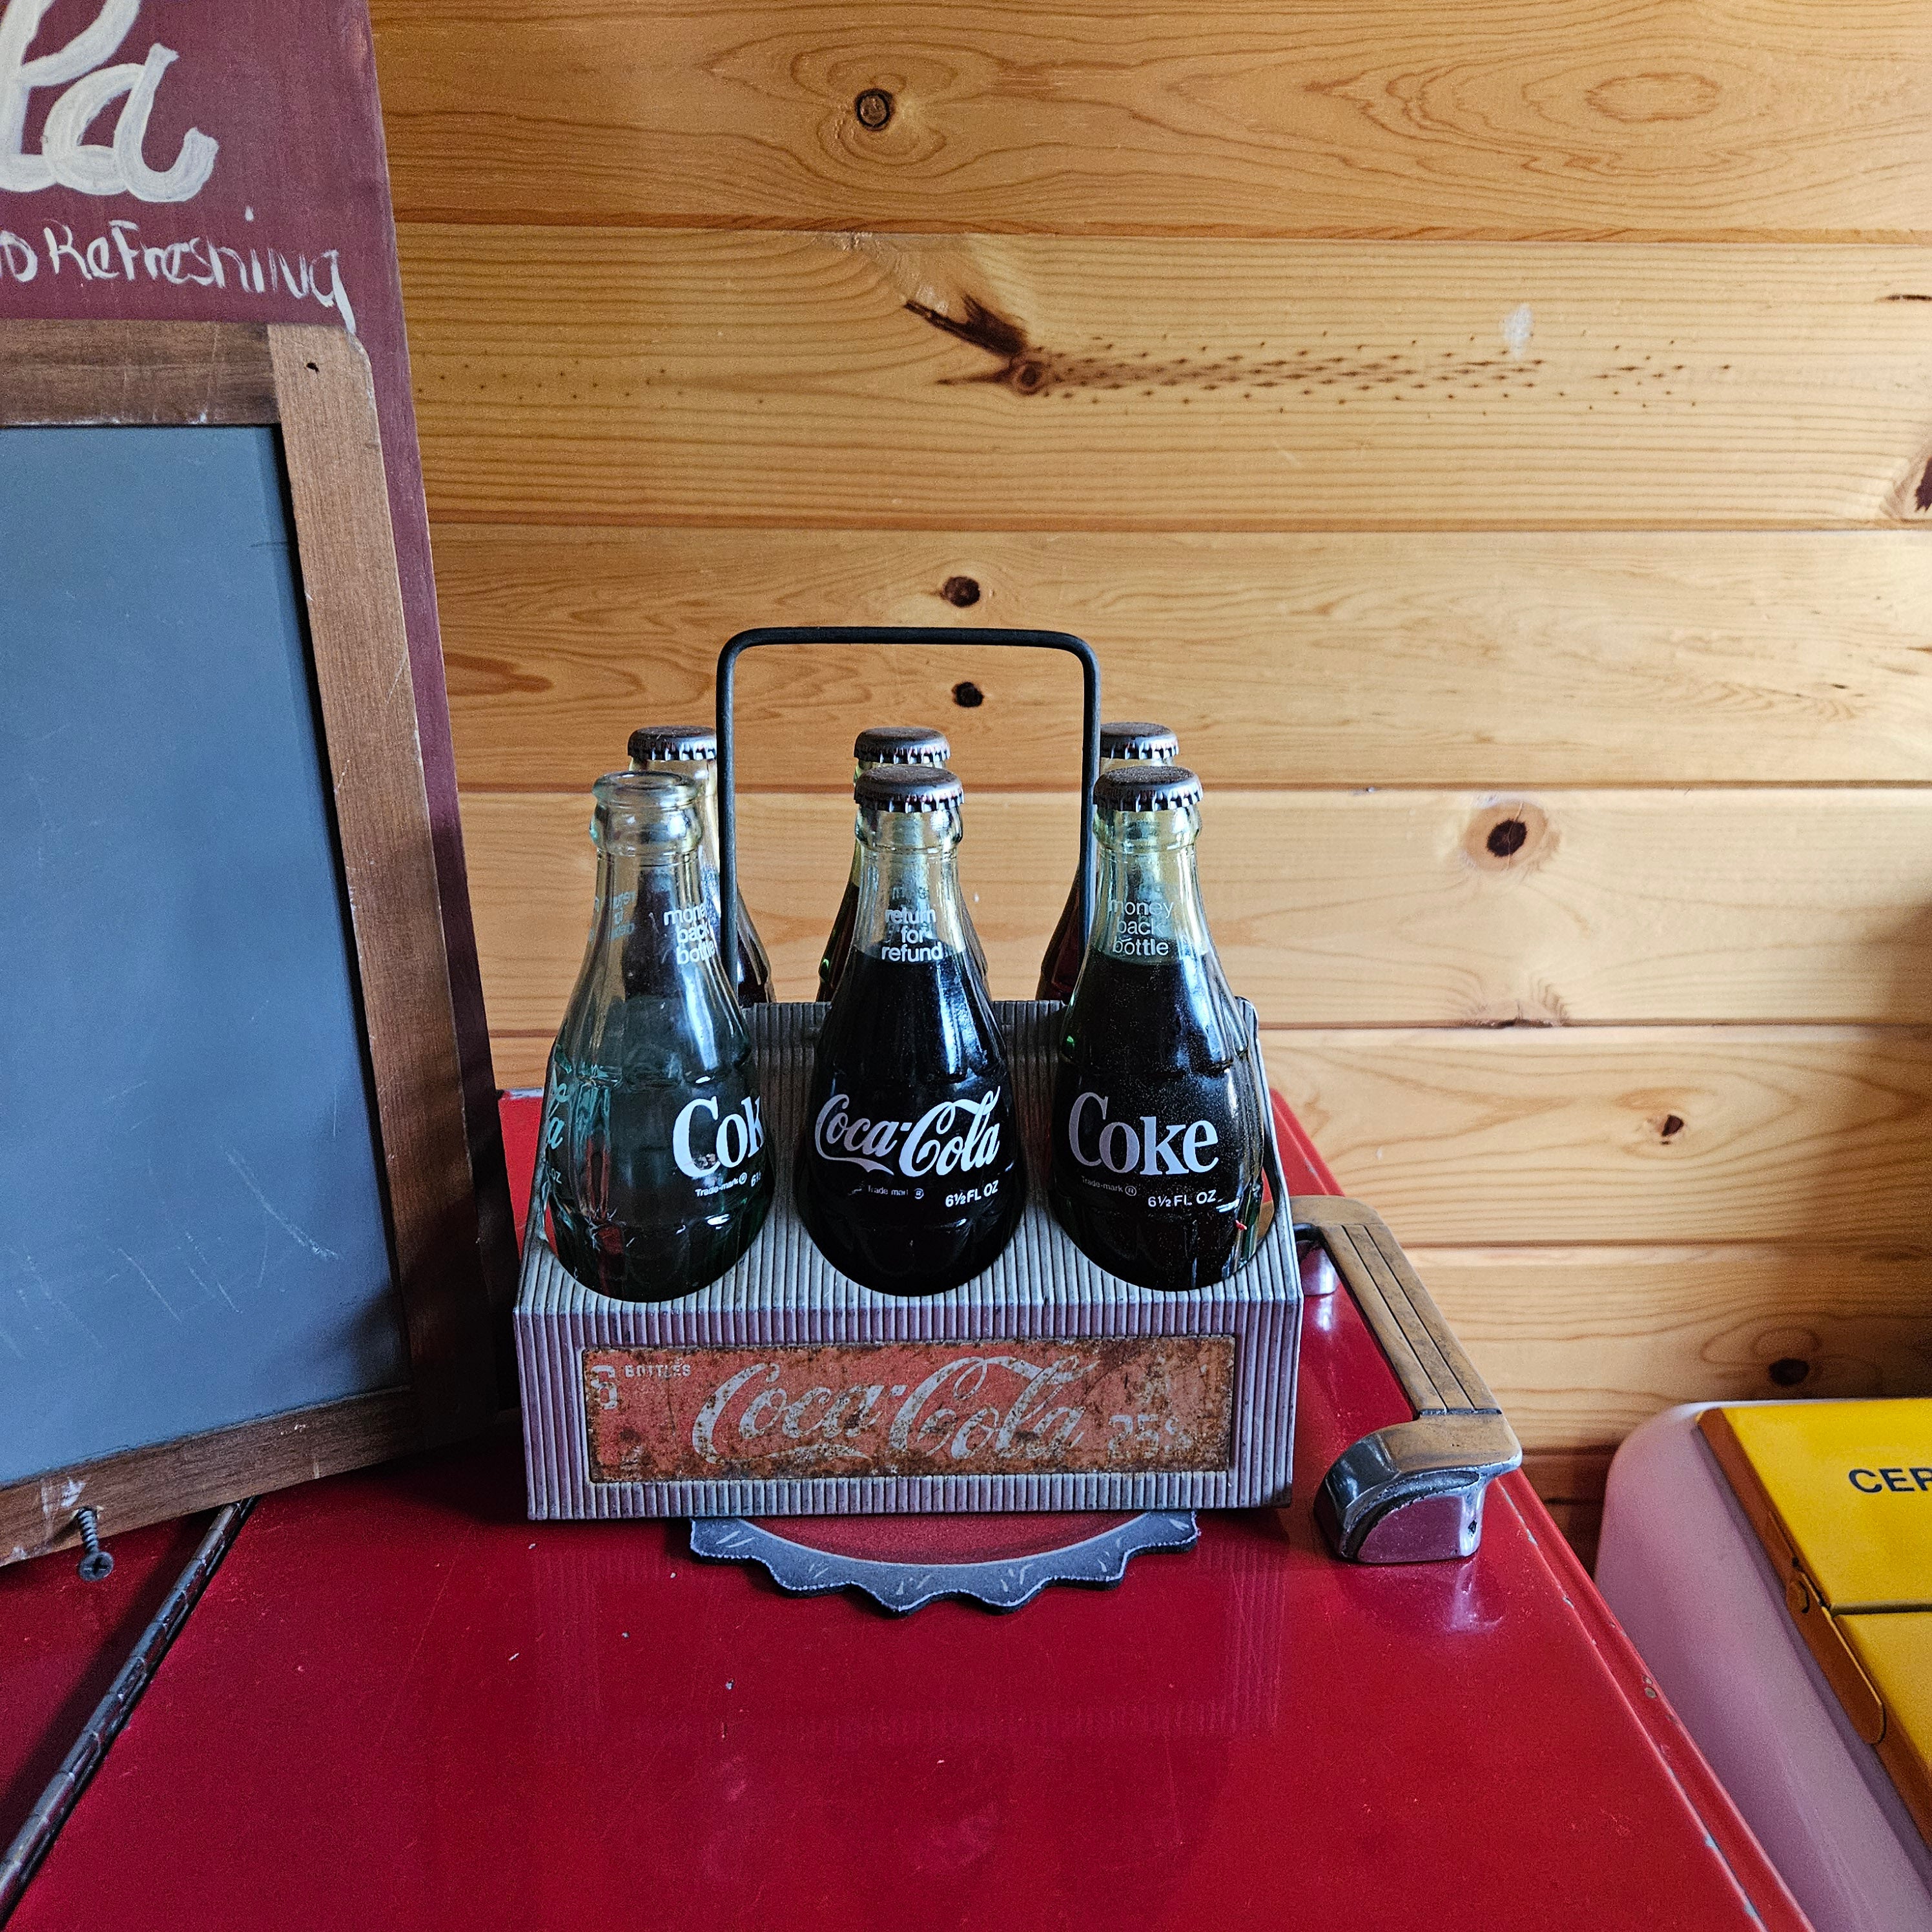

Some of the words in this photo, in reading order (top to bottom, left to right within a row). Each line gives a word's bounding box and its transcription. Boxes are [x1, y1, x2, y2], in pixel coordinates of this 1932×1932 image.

[885, 906, 936, 924] return
[1109, 899, 1174, 919] money
[901, 925, 926, 943] for
[1117, 917, 1163, 935] back
[881, 941, 943, 962] refund
[1113, 936, 1169, 956] bottle
[815, 1086, 1001, 1177] Coca-Cola
[1069, 1093, 1219, 1176] Coke
[983, 1180, 999, 1197] OZ
[1196, 1189, 1217, 1204] OZ
[624, 1363, 692, 1378] BOTTLES
[692, 1356, 1100, 1464] Coca-Cola
